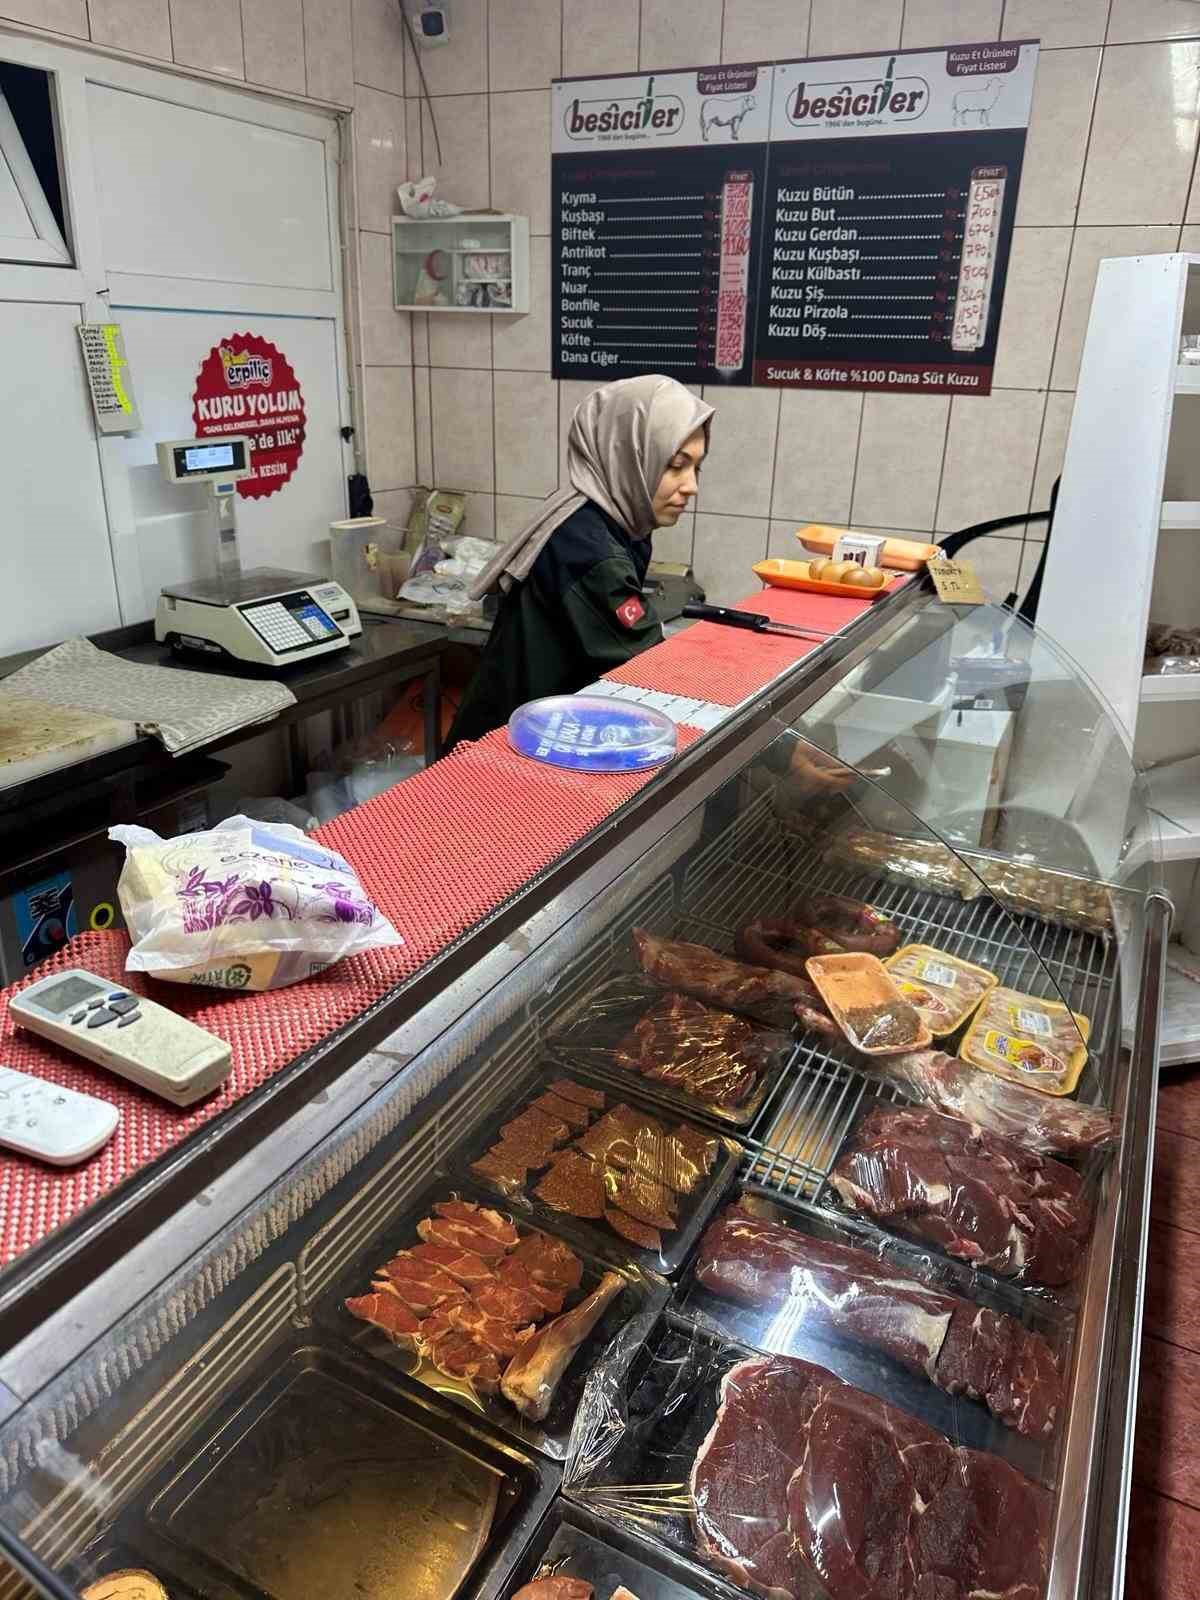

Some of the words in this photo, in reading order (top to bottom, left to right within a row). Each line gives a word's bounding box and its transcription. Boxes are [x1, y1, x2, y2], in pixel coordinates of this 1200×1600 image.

[561, 192, 597, 207] Kıyma
[777, 188, 809, 202] Kuzu
[813, 185, 854, 201] Bütün
[561, 209, 605, 224] Kuşbaşı
[776, 208, 808, 222] Kuzu
[811, 207, 836, 221] But
[561, 227, 596, 240] Biftek
[774, 227, 807, 241] Kuzu
[810, 225, 858, 240] Gerdan
[561, 245, 607, 258] Antrikot
[773, 247, 805, 261] Kuzu
[808, 246, 860, 263] Kuşbaşı
[561, 263, 591, 278] Tranç
[772, 266, 804, 280] Kuzu
[807, 266, 861, 280] Külbastı
[561, 281, 588, 294] Nuar
[770, 285, 802, 299] Kuzu
[805, 285, 824, 302] Şiş
[561, 298, 600, 311] Bonfile
[769, 304, 801, 318] Kuzu
[803, 304, 848, 319] Pirzola
[561, 316, 594, 329] Sucuk
[561, 332, 591, 346] Köfte
[768, 323, 799, 337] Kuzu
[802, 323, 827, 340] Döş
[561, 350, 589, 363] Dana
[590, 350, 619, 367] Ciğer
[767, 367, 800, 380] Sucuk
[803, 368, 813, 381] &
[815, 368, 848, 382] Köfte
[850, 370, 886, 383] %100
[888, 371, 920, 384] Dana
[922, 371, 944, 385] Süt
[947, 373, 979, 386] Kuzu
[197, 394, 246, 421] KURU
[246, 390, 301, 416] YOLUM
[260, 462, 287, 478] KESİM
